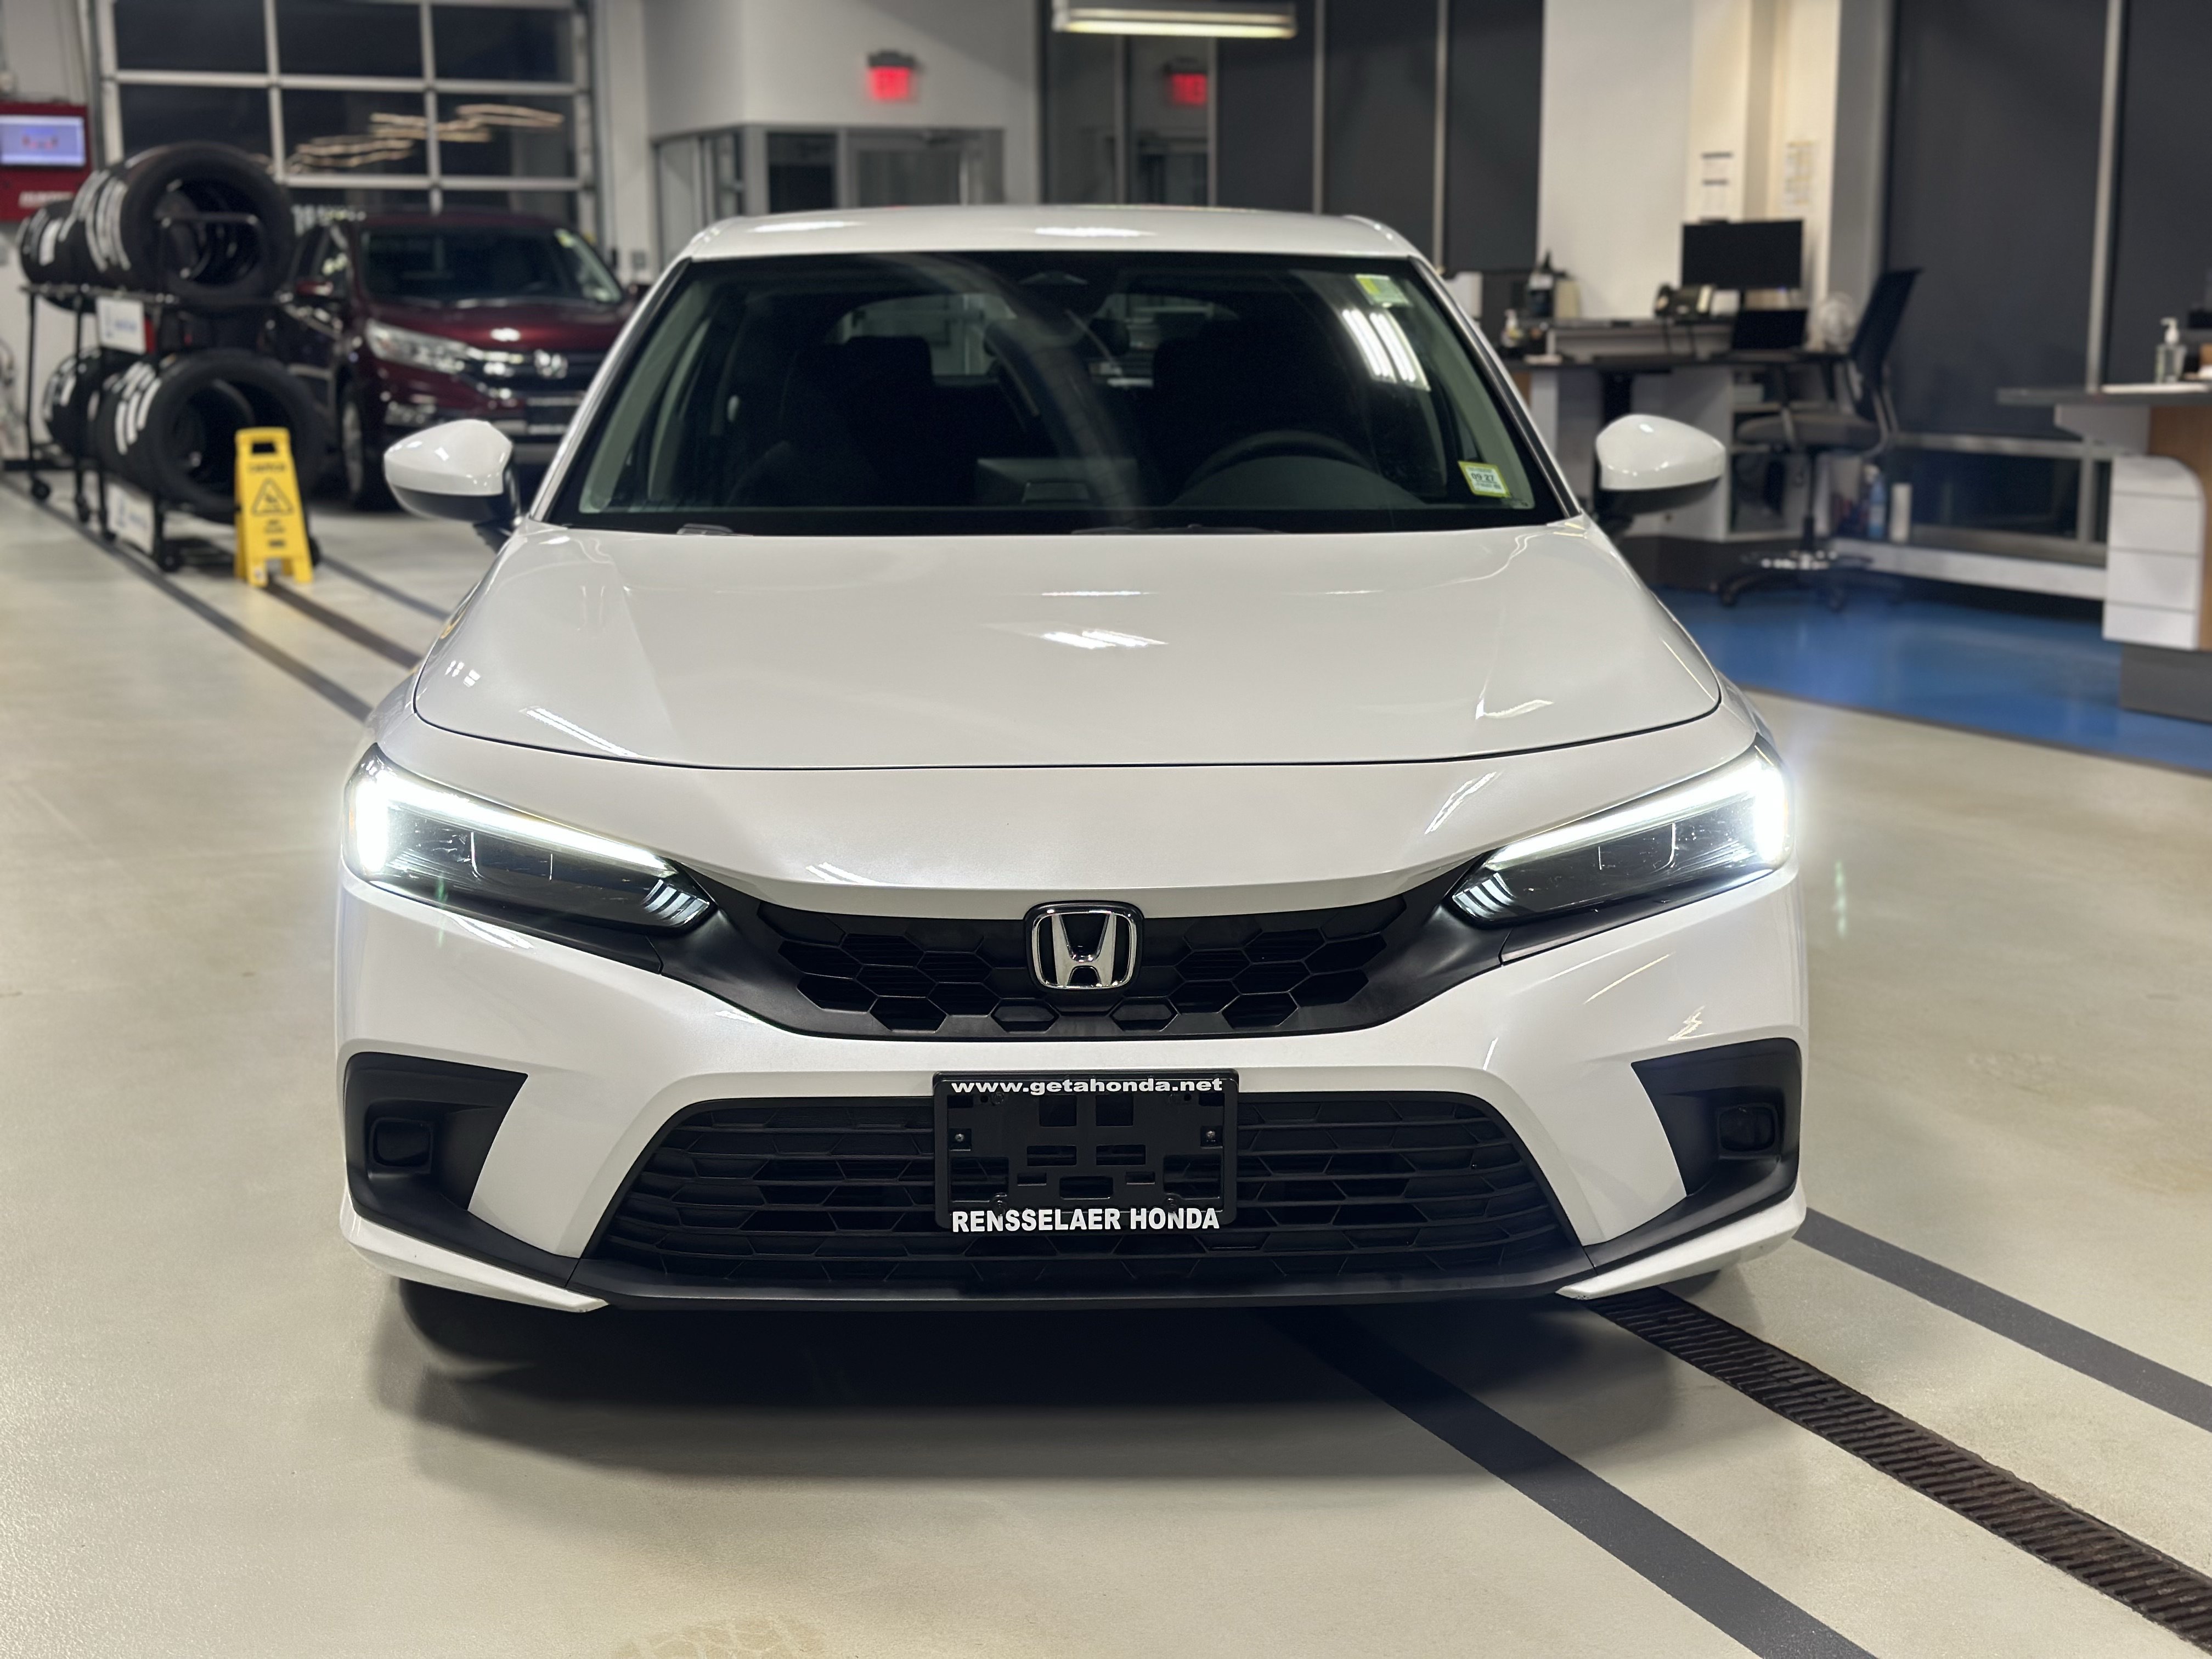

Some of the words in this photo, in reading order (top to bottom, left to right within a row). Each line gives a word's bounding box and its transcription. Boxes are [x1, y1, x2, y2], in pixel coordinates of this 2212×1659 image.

[951, 1078, 1222, 1096] www.getahonda.net
[952, 1208, 1121, 1232] RENSSELAER
[1130, 1207, 1220, 1229] HONDA
